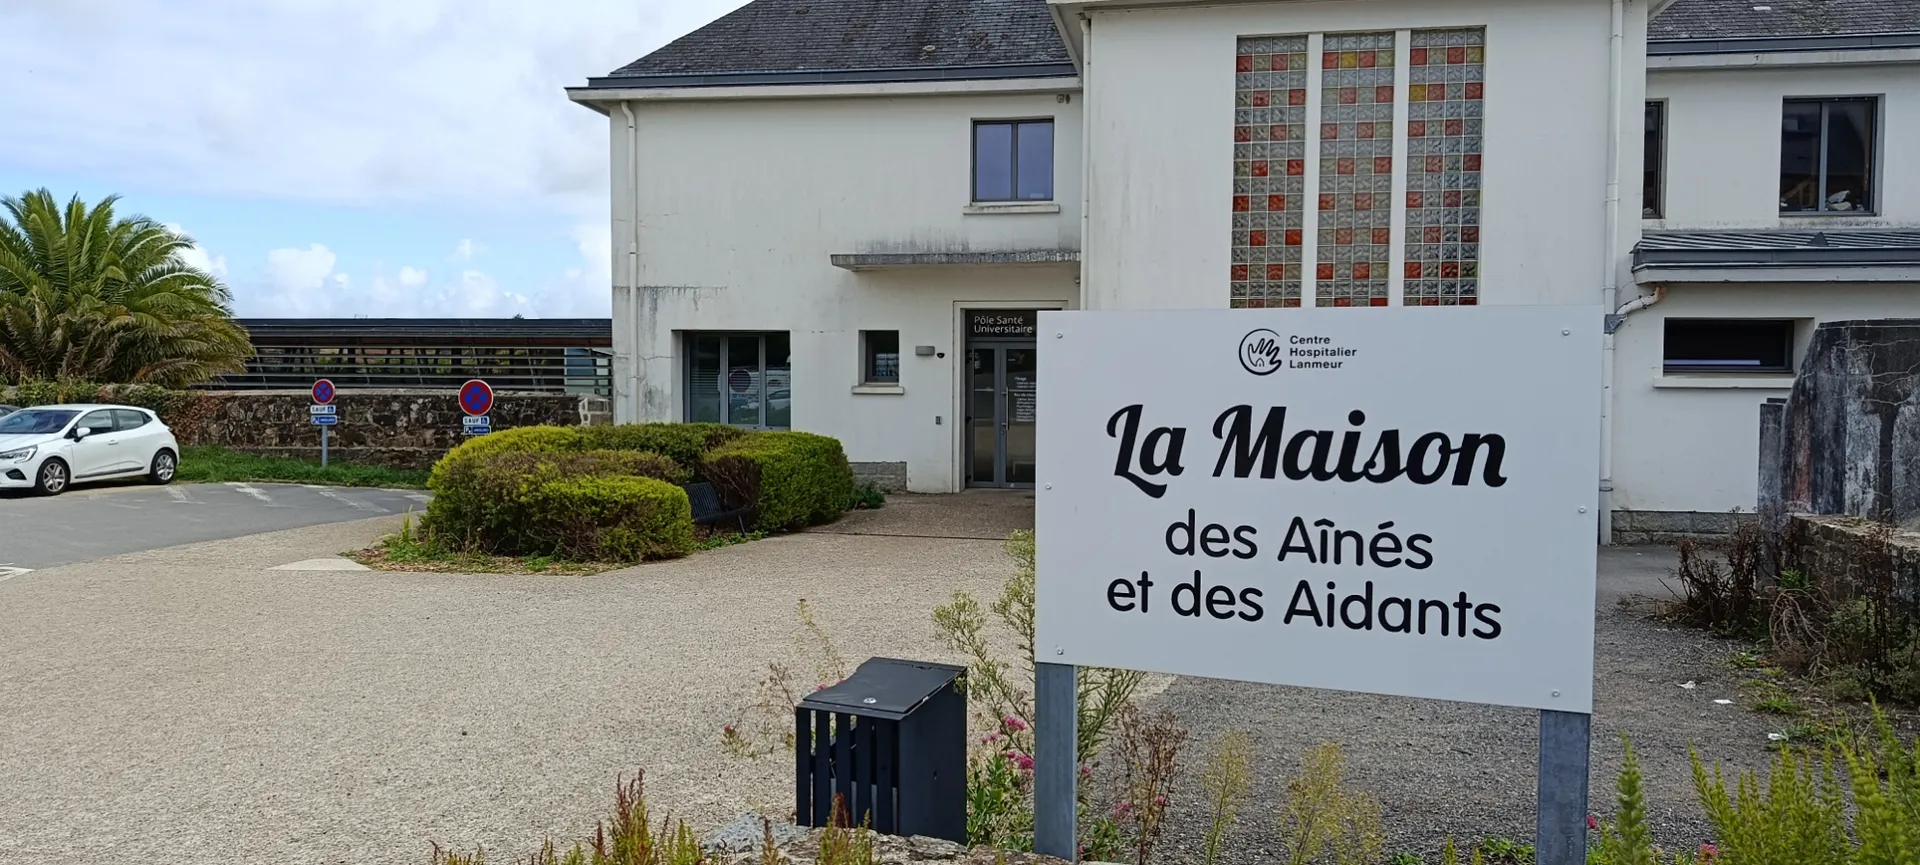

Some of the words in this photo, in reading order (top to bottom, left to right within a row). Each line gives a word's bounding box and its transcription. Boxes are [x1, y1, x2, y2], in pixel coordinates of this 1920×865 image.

[974, 315, 994, 325] Pôle
[996, 315, 1024, 325] Santé
[974, 325, 1033, 334] Universitaire
[1289, 335, 1331, 345] Centre
[1289, 347, 1358, 359] Hospitalier
[1289, 359, 1344, 369] Lanmeur
[1106, 404, 1187, 499] La
[1211, 404, 1508, 488] Maison
[1165, 507, 1258, 560] des
[1277, 516, 1434, 570] Aînés
[1106, 570, 1154, 614] et
[1170, 569, 1264, 622] des
[1283, 579, 1502, 640] Aidants
